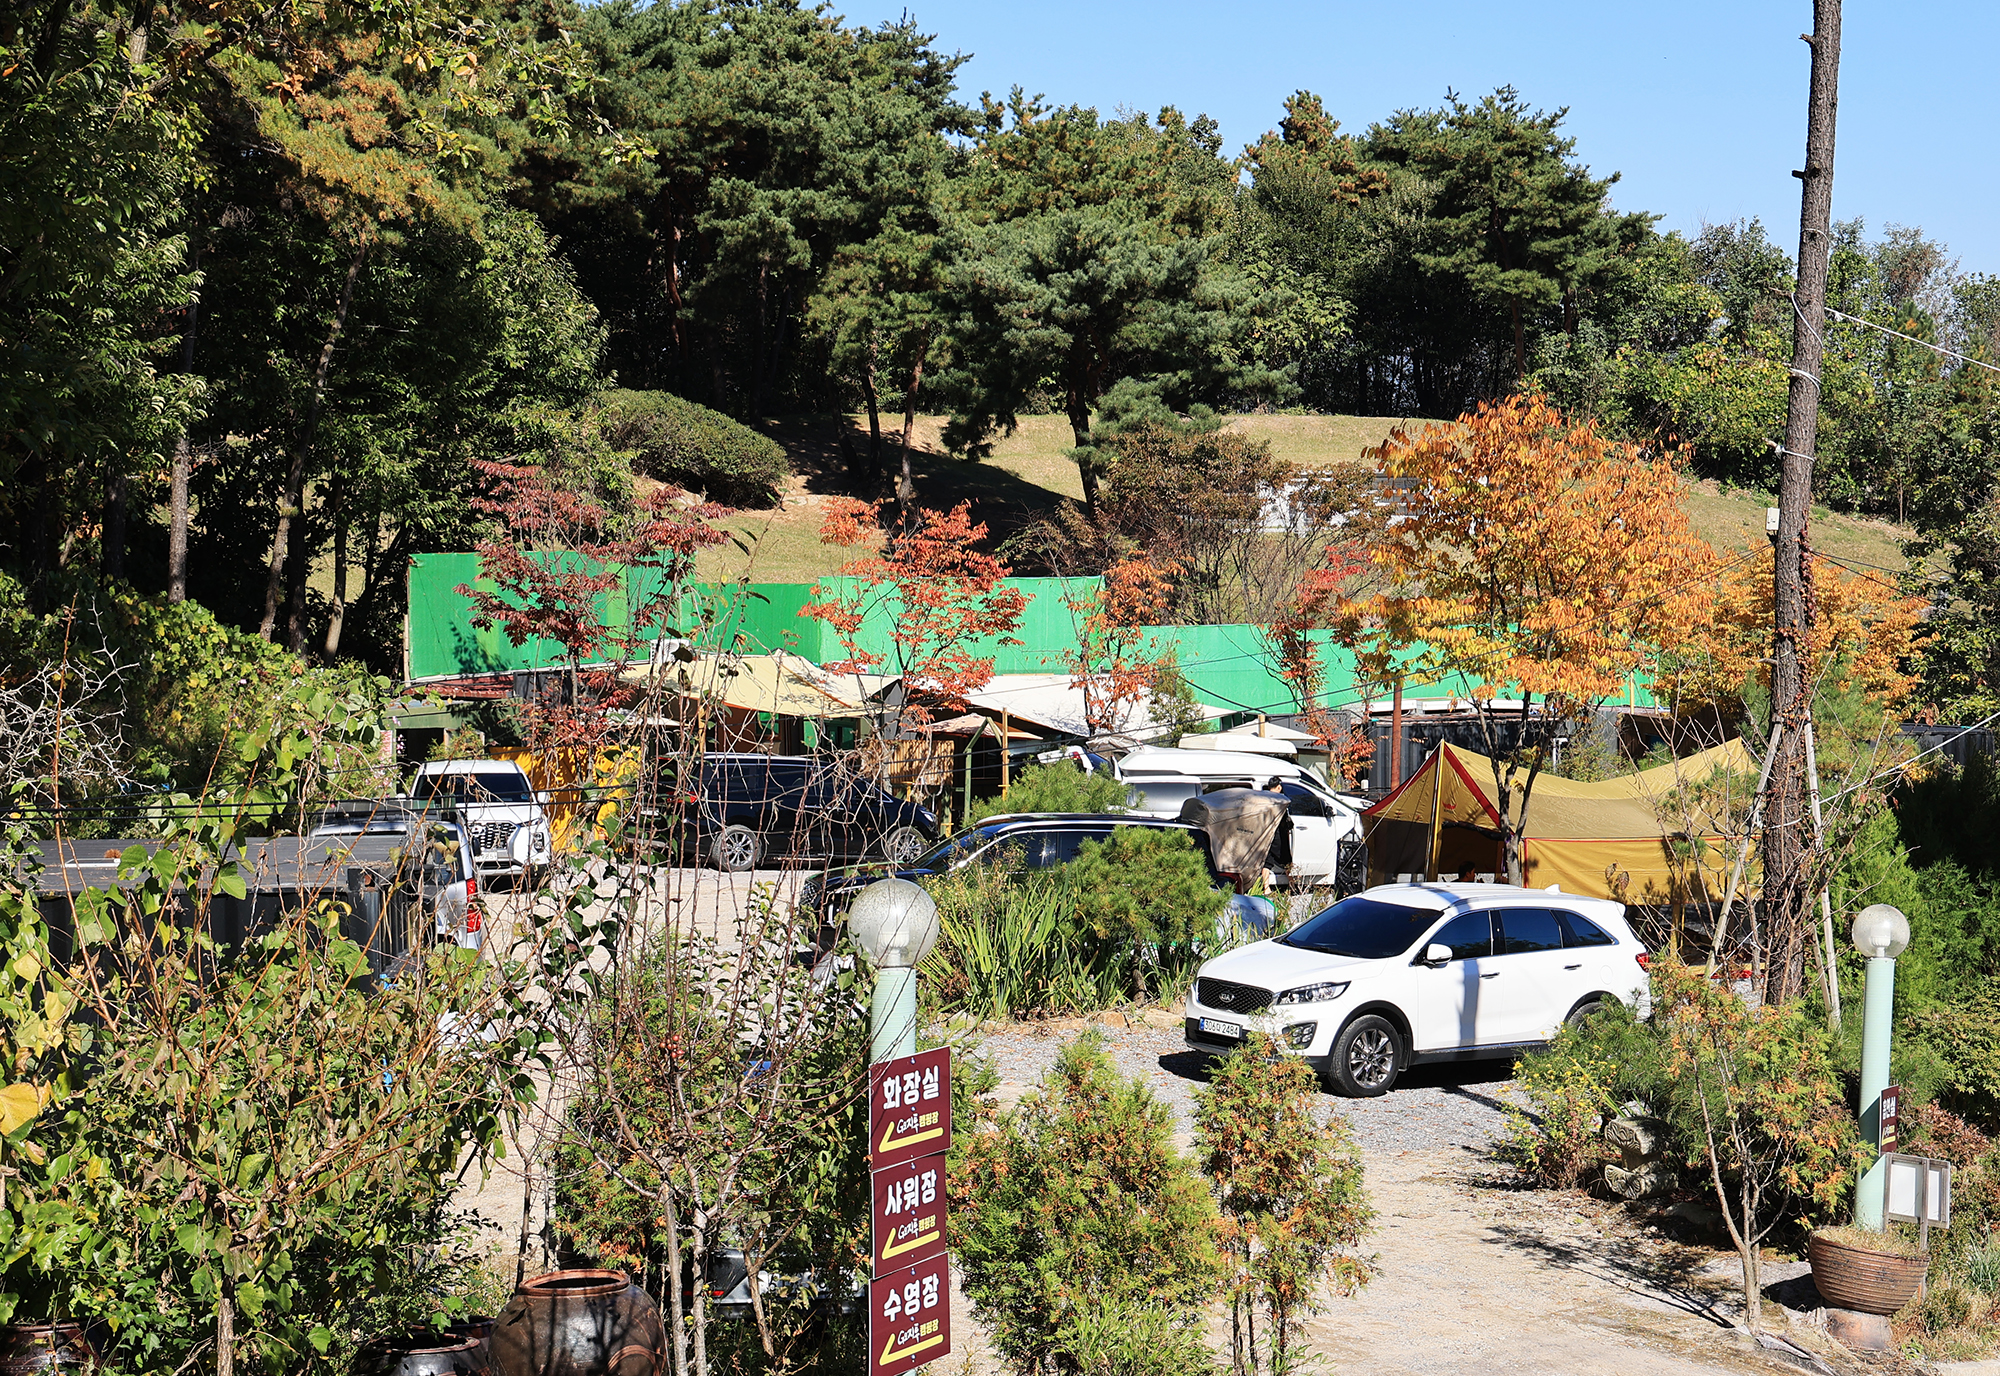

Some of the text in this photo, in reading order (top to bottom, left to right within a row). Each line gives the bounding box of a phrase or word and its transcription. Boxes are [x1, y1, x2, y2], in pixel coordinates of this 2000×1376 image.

[1222, 1023, 1239, 1036] 2484
[883, 1065, 940, 1110] 화장실
[884, 1169, 937, 1216] 샤워장
[883, 1273, 939, 1322] 수영장
